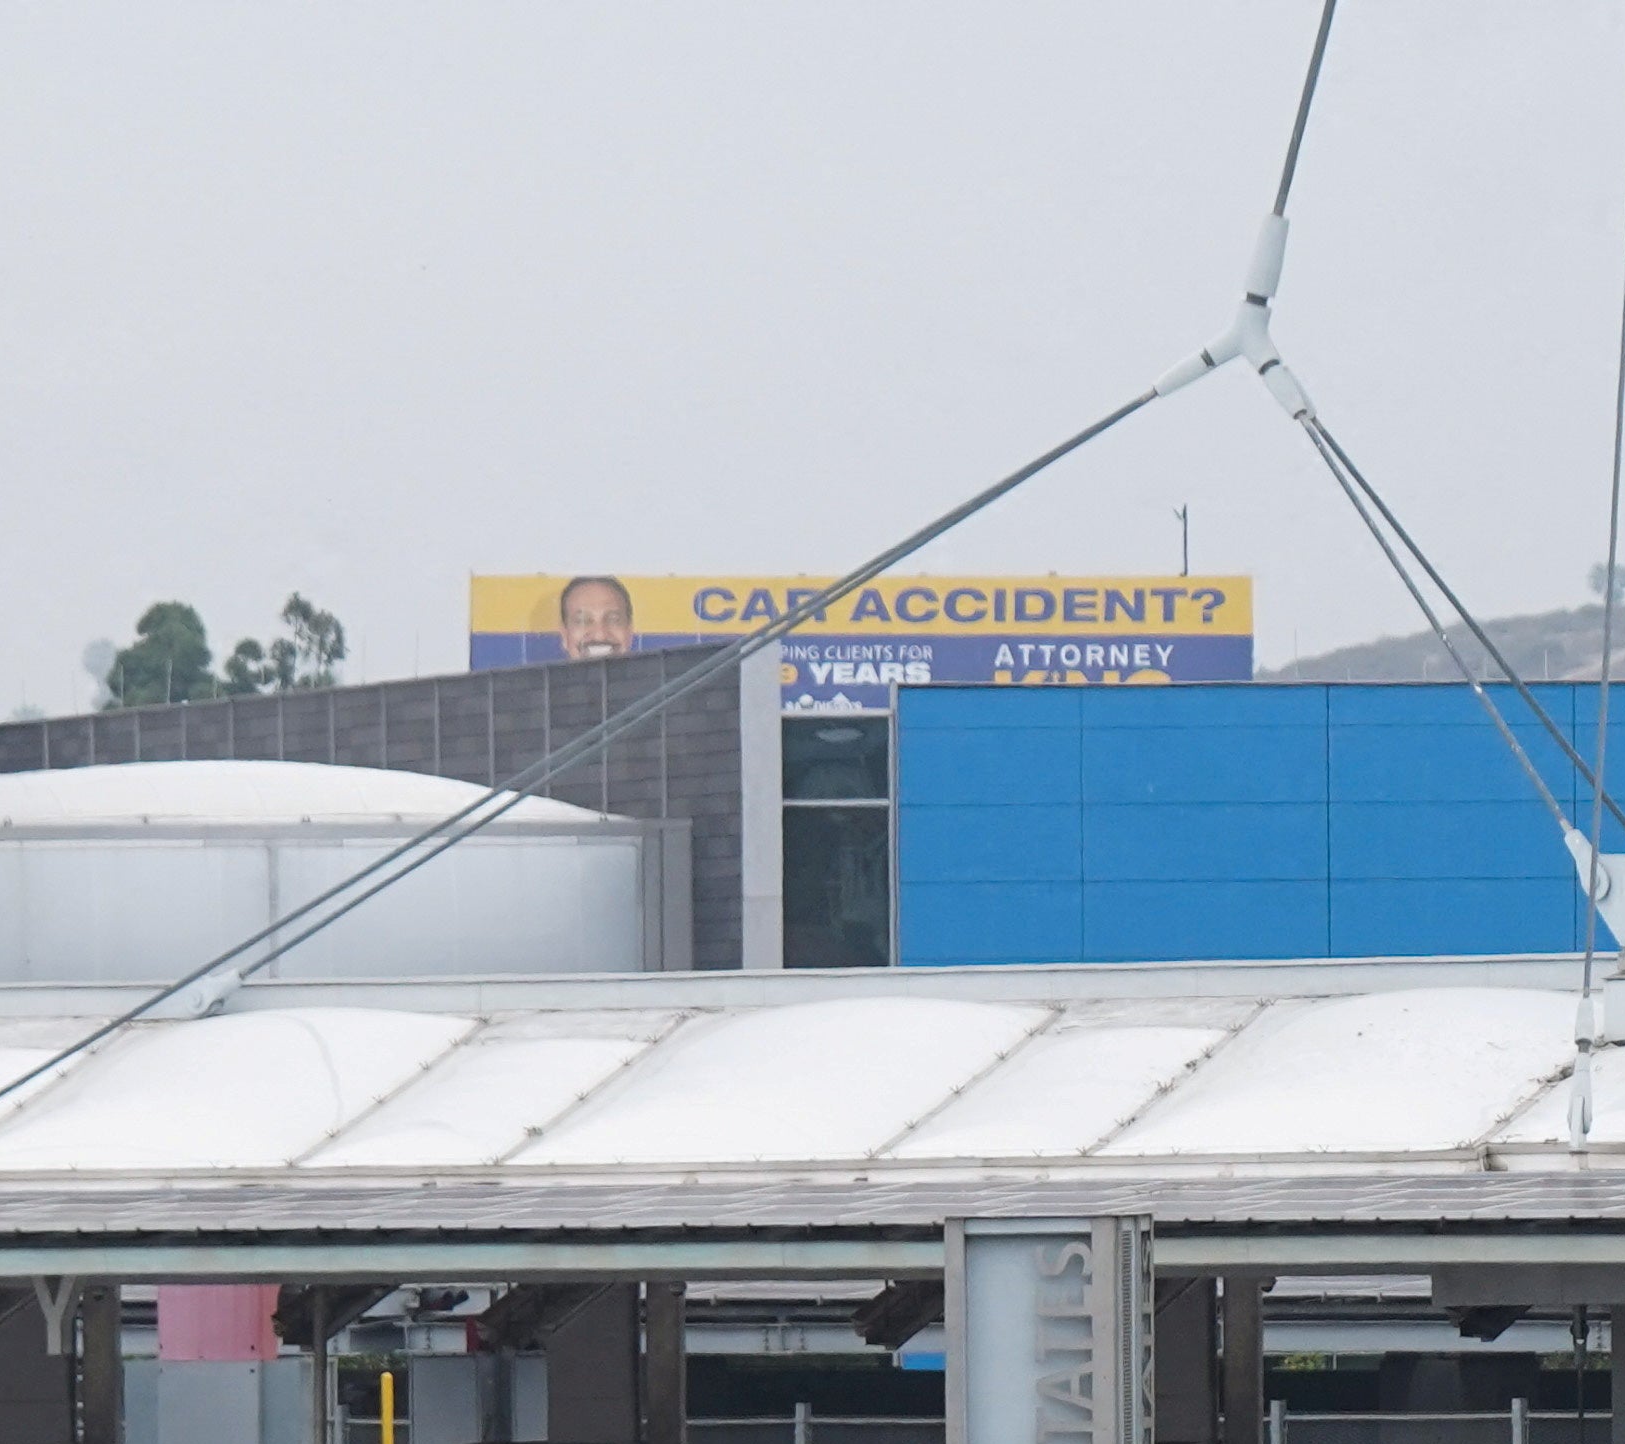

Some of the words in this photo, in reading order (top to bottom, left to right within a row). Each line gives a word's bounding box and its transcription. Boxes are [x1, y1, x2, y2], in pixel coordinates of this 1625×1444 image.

[849, 587, 1228, 623] ACCIDENT?
[825, 645, 893, 661] CLIENTS
[899, 645, 934, 661] FOR
[994, 643, 1175, 668] ATTORNEY
[808, 661, 932, 686] YEARS
